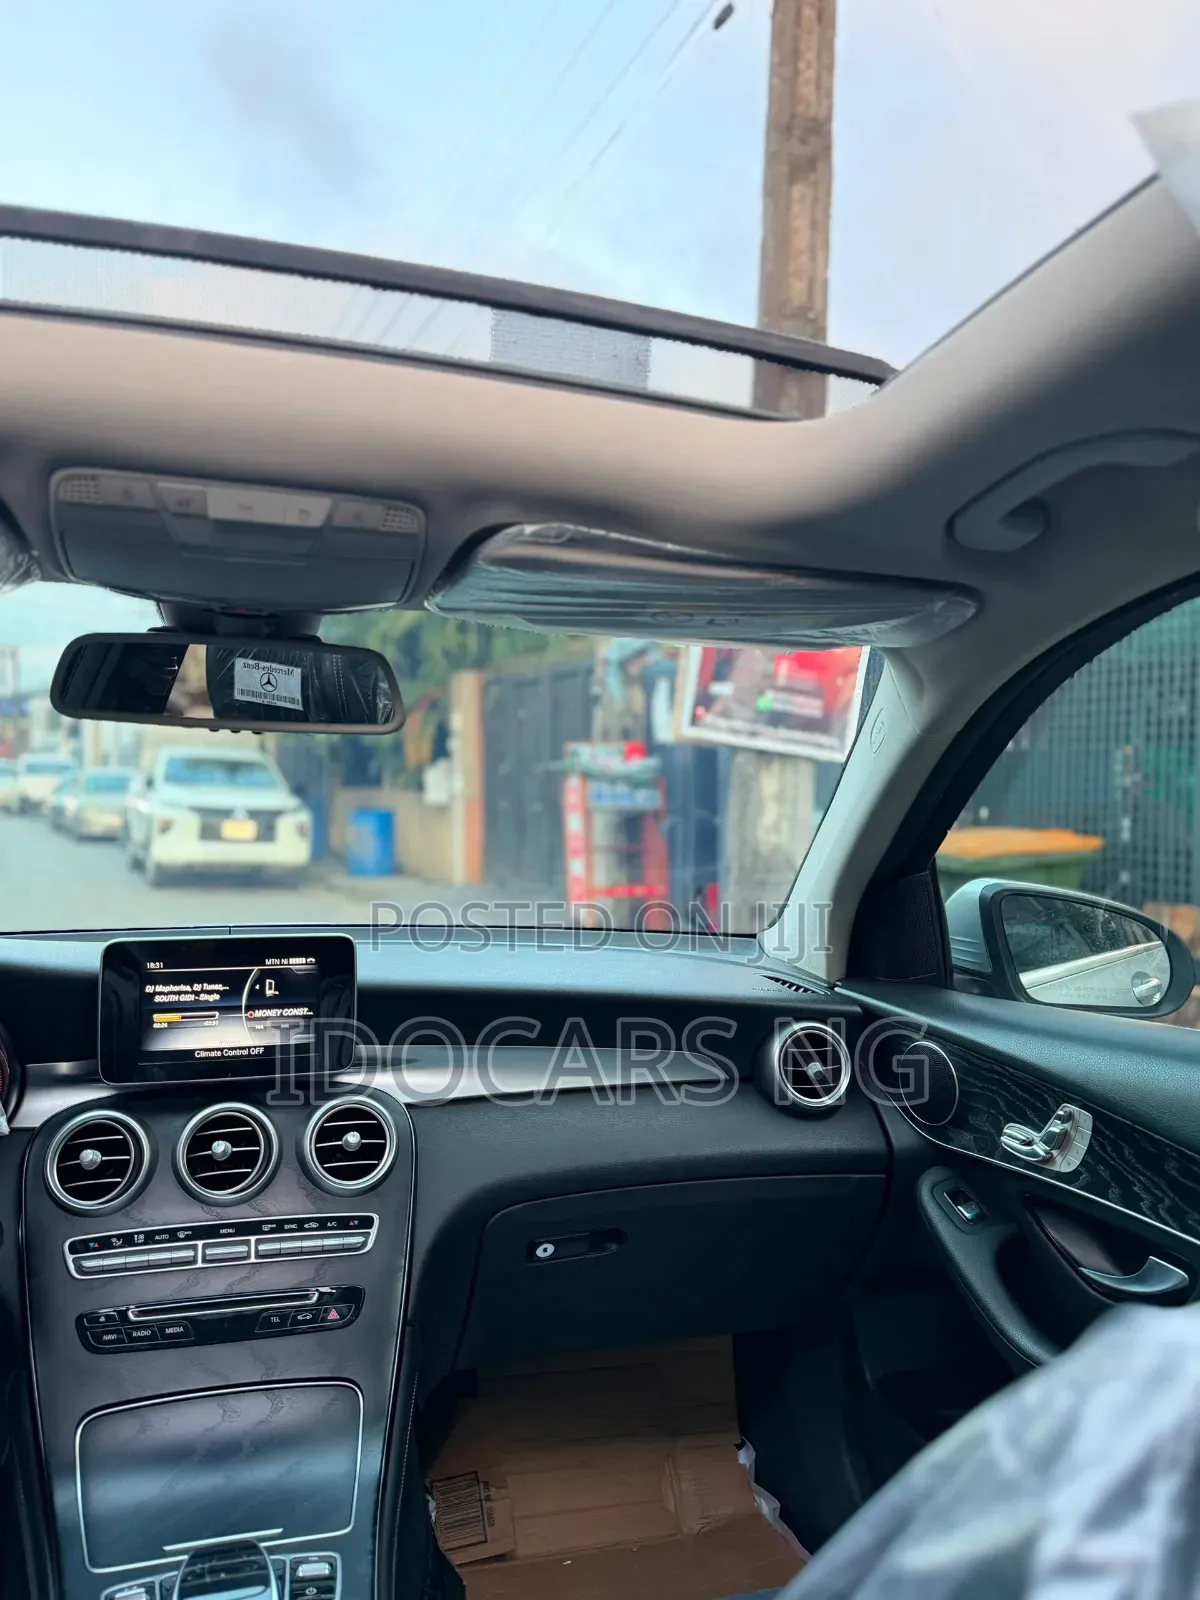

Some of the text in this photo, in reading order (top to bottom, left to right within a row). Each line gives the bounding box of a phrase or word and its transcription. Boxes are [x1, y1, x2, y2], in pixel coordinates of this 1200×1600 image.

[145, 985, 155, 993] DJ
[193, 983, 202, 991] DJ
[154, 994, 179, 1003] SOUTH
[179, 993, 195, 1001] GIDI
[199, 993, 220, 1002] Single
[254, 1008, 282, 1017] MONEY
[194, 1047, 265, 1058] Climate Control OFF
[132, 1329, 151, 1338] RADIO
[165, 1326, 184, 1334] MEDIA
[103, 1333, 117, 1341] NAVI
